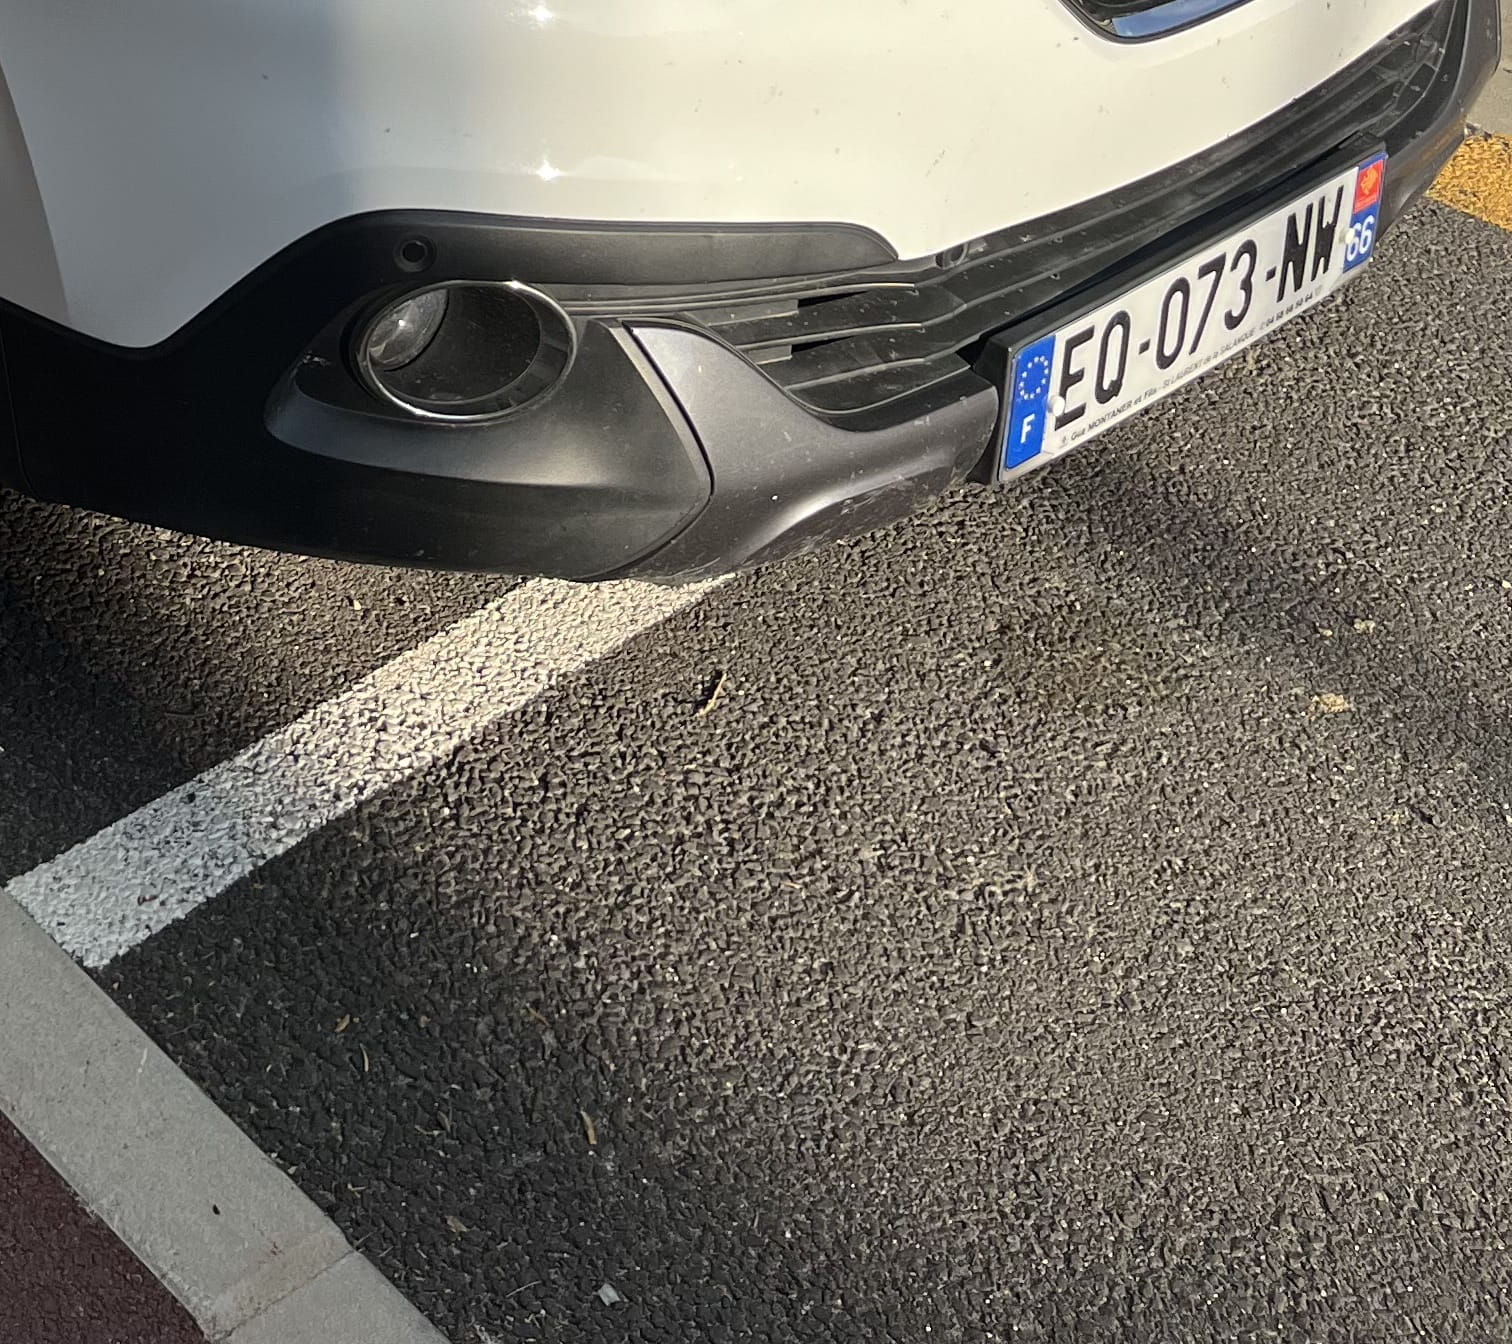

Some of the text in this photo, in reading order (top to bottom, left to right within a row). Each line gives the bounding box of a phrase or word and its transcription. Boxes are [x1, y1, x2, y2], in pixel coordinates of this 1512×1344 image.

[1346, 214, 1376, 262] 66
[1054, 186, 1344, 431] EQ-073-NW
[1020, 414, 1035, 445] F
